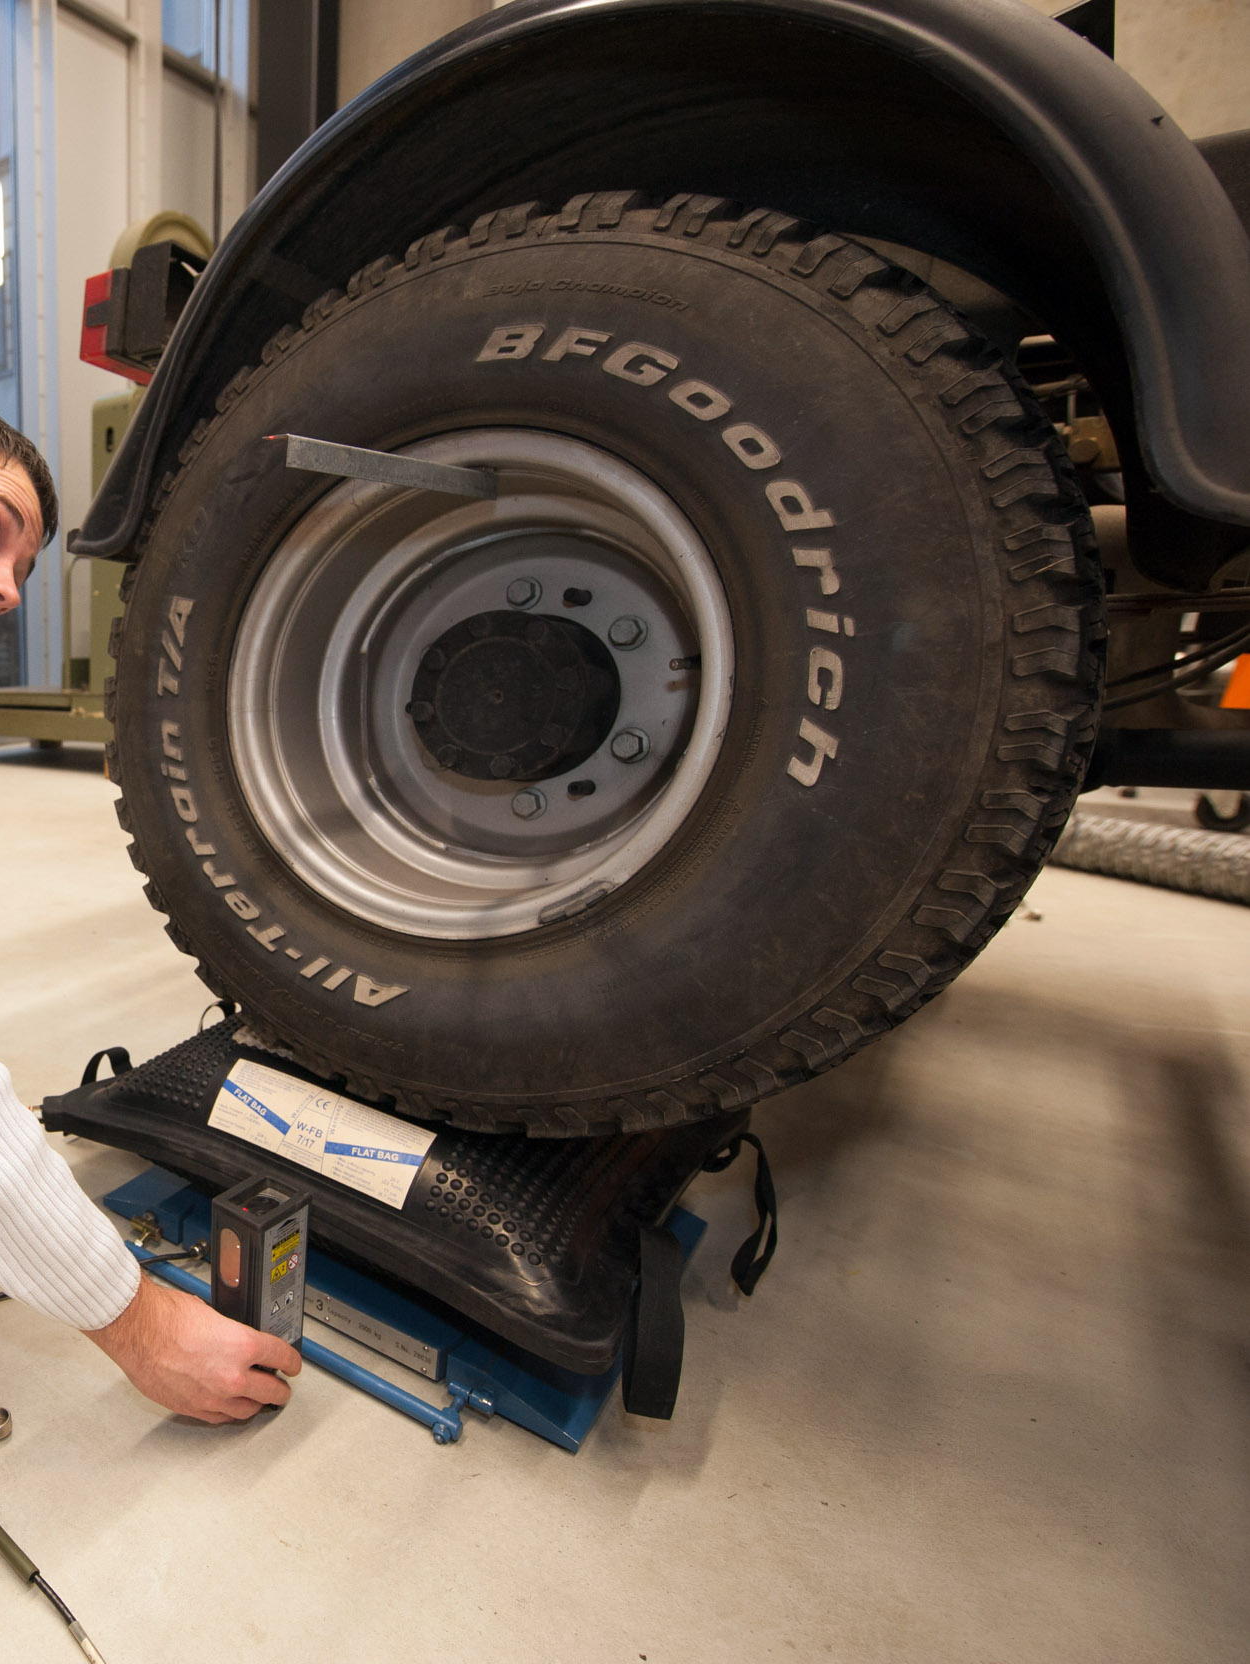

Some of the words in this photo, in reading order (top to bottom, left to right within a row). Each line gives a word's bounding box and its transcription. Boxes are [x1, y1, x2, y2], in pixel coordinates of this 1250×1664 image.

[549, 278, 690, 313] Champion
[474, 323, 856, 788] BFGoodrich
[157, 595, 196, 696] T/A
[161, 720, 411, 1008] All-Terrain
[233, 1088, 253, 1105] FLAT
[250, 1101, 268, 1117] BAG
[296, 1120, 323, 1139] W-FB
[296, 1134, 316, 1149] 7/17
[351, 1147, 376, 1158] FLAT
[376, 1151, 399, 1162] BAG
[316, 1299, 324, 1311] 3
